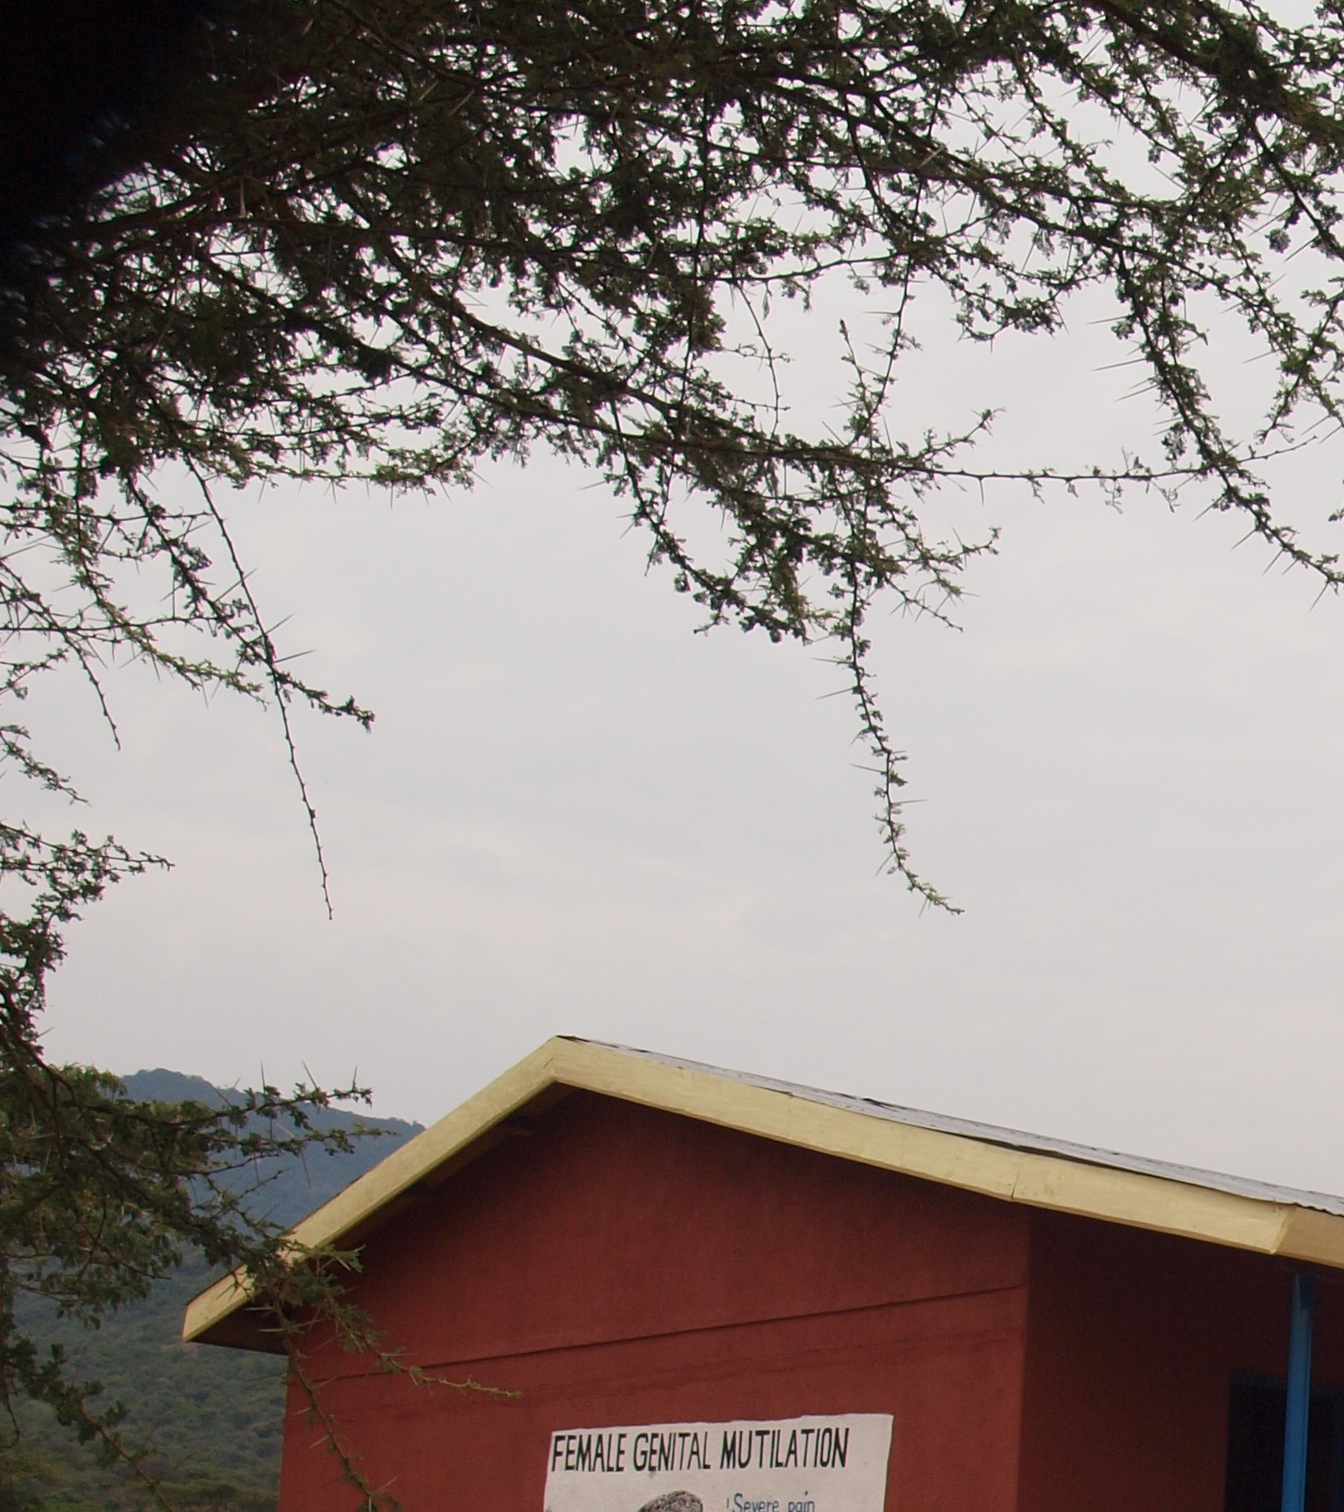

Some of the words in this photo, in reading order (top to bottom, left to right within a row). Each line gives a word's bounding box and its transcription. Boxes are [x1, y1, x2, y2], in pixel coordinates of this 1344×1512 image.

[551, 1433, 627, 1472] FEMALE
[633, 1431, 711, 1471] GENITAL
[720, 1427, 849, 1469] MUTILATION
